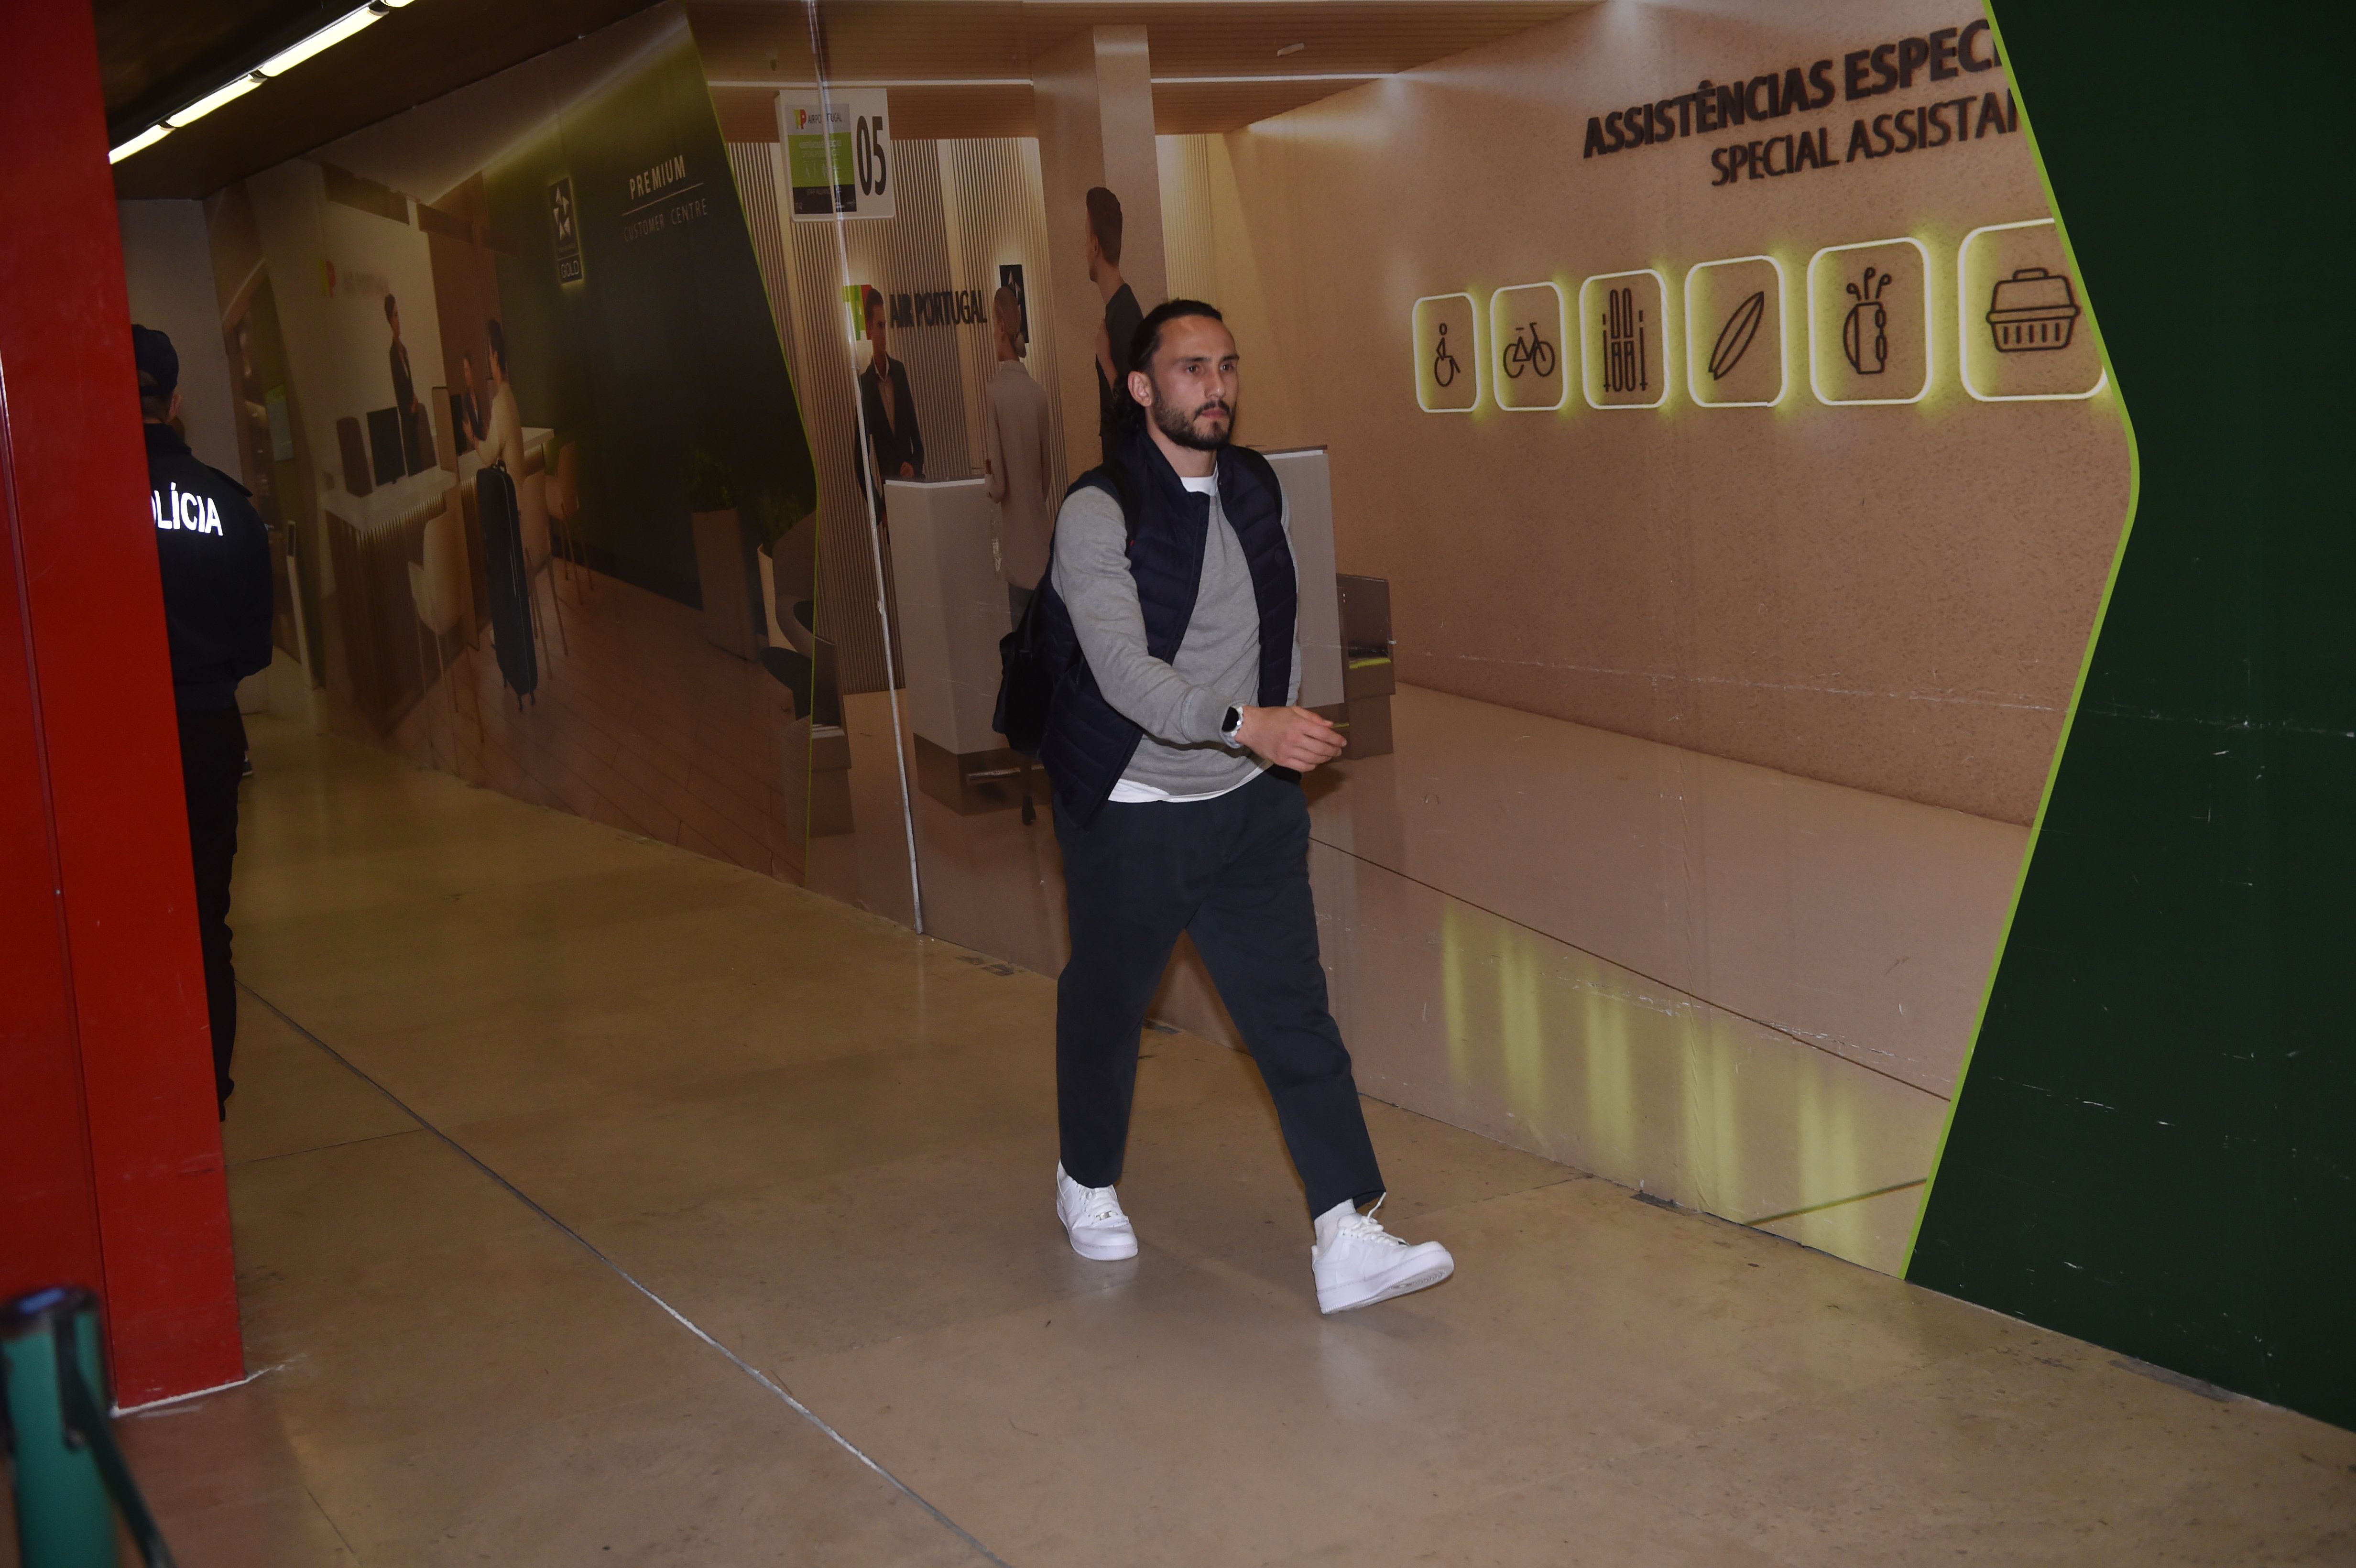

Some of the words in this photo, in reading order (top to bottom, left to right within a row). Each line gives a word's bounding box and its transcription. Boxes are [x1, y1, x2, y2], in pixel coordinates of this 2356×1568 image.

[815, 113, 842, 123] POTUGAL
[1583, 60, 1834, 158] ASSISTÊNCIAS
[629, 155, 686, 199] PREMIUM
[857, 115, 886, 196] 05
[1711, 128, 1839, 186] SPECIAL
[624, 214, 665, 241] CUSTOMER
[671, 198, 708, 225] CENTRE
[561, 260, 579, 278] GOLD
[890, 294, 914, 328] AIR
[914, 290, 987, 326] PORTUGAL
